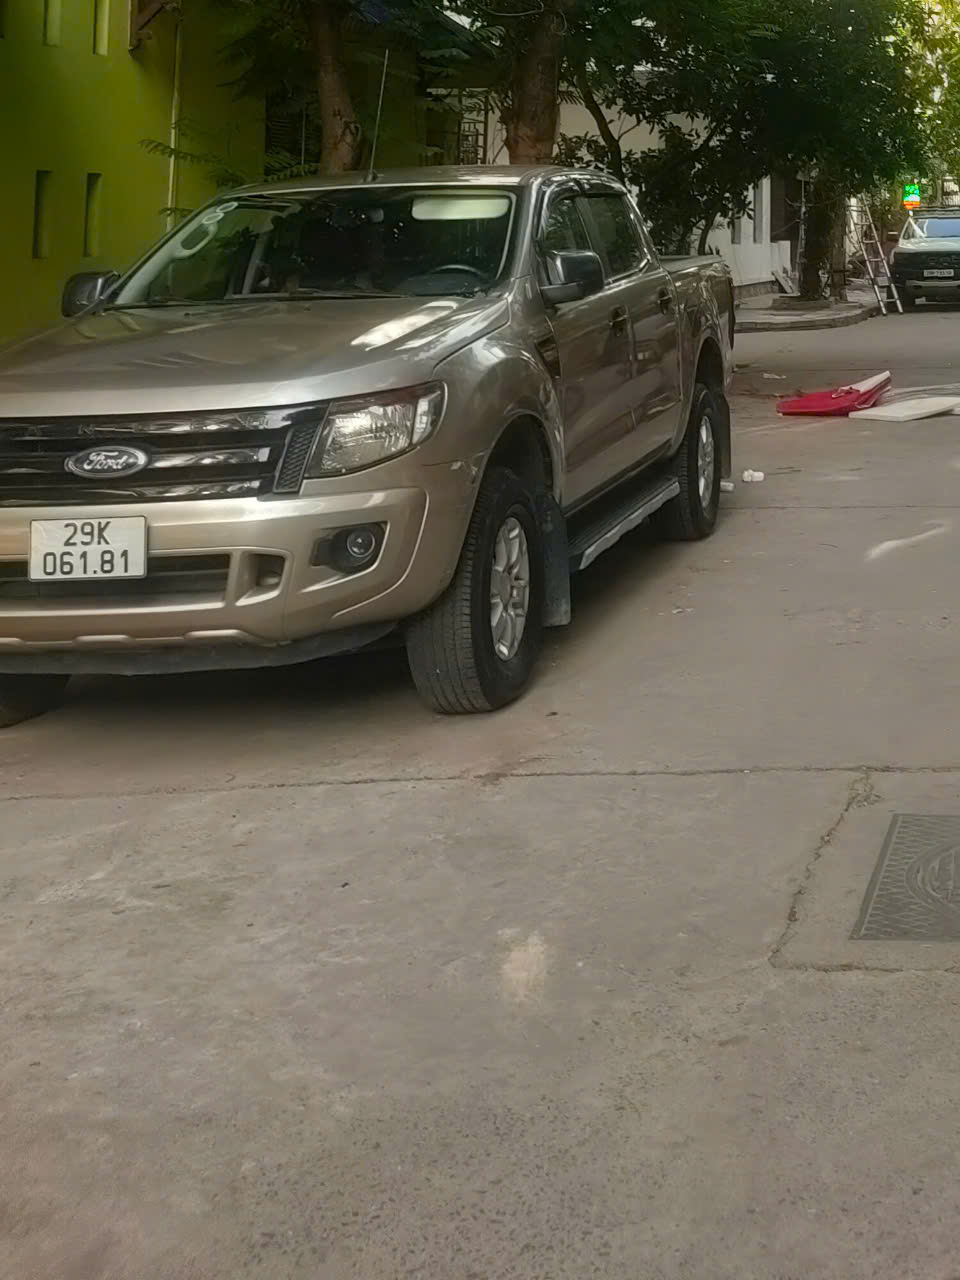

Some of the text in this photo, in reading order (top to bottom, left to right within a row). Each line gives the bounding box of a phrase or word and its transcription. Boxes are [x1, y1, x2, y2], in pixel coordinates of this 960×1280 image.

[83, 451, 129, 470] Ford
[63, 520, 112, 548] 29K
[42, 549, 129, 576] 061.81
